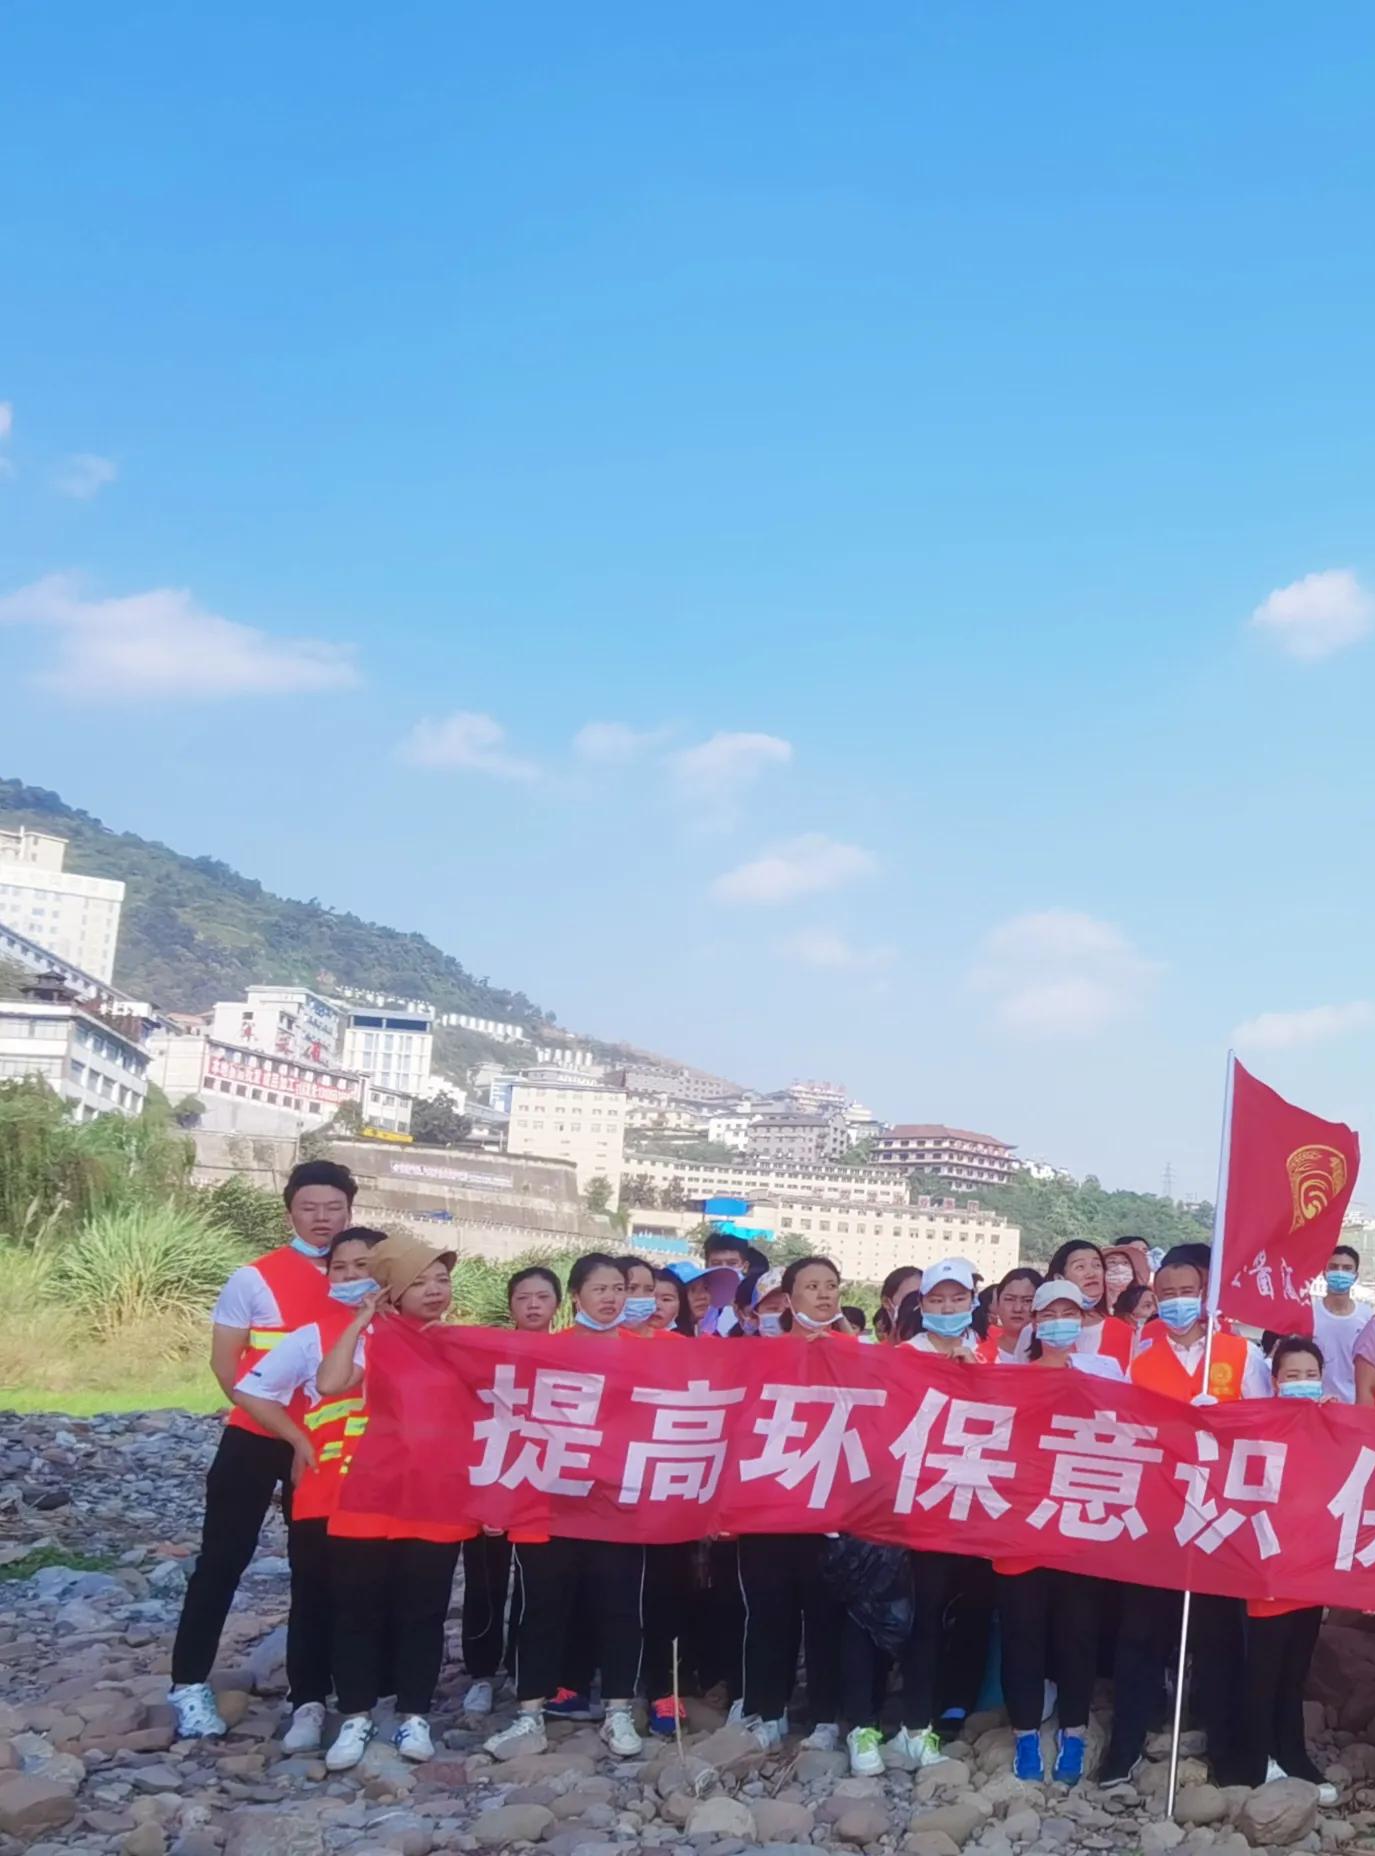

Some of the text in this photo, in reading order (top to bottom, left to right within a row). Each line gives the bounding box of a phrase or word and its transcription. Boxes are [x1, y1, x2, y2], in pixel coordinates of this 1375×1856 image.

[467, 1364, 1288, 1560] 提高环保意识
